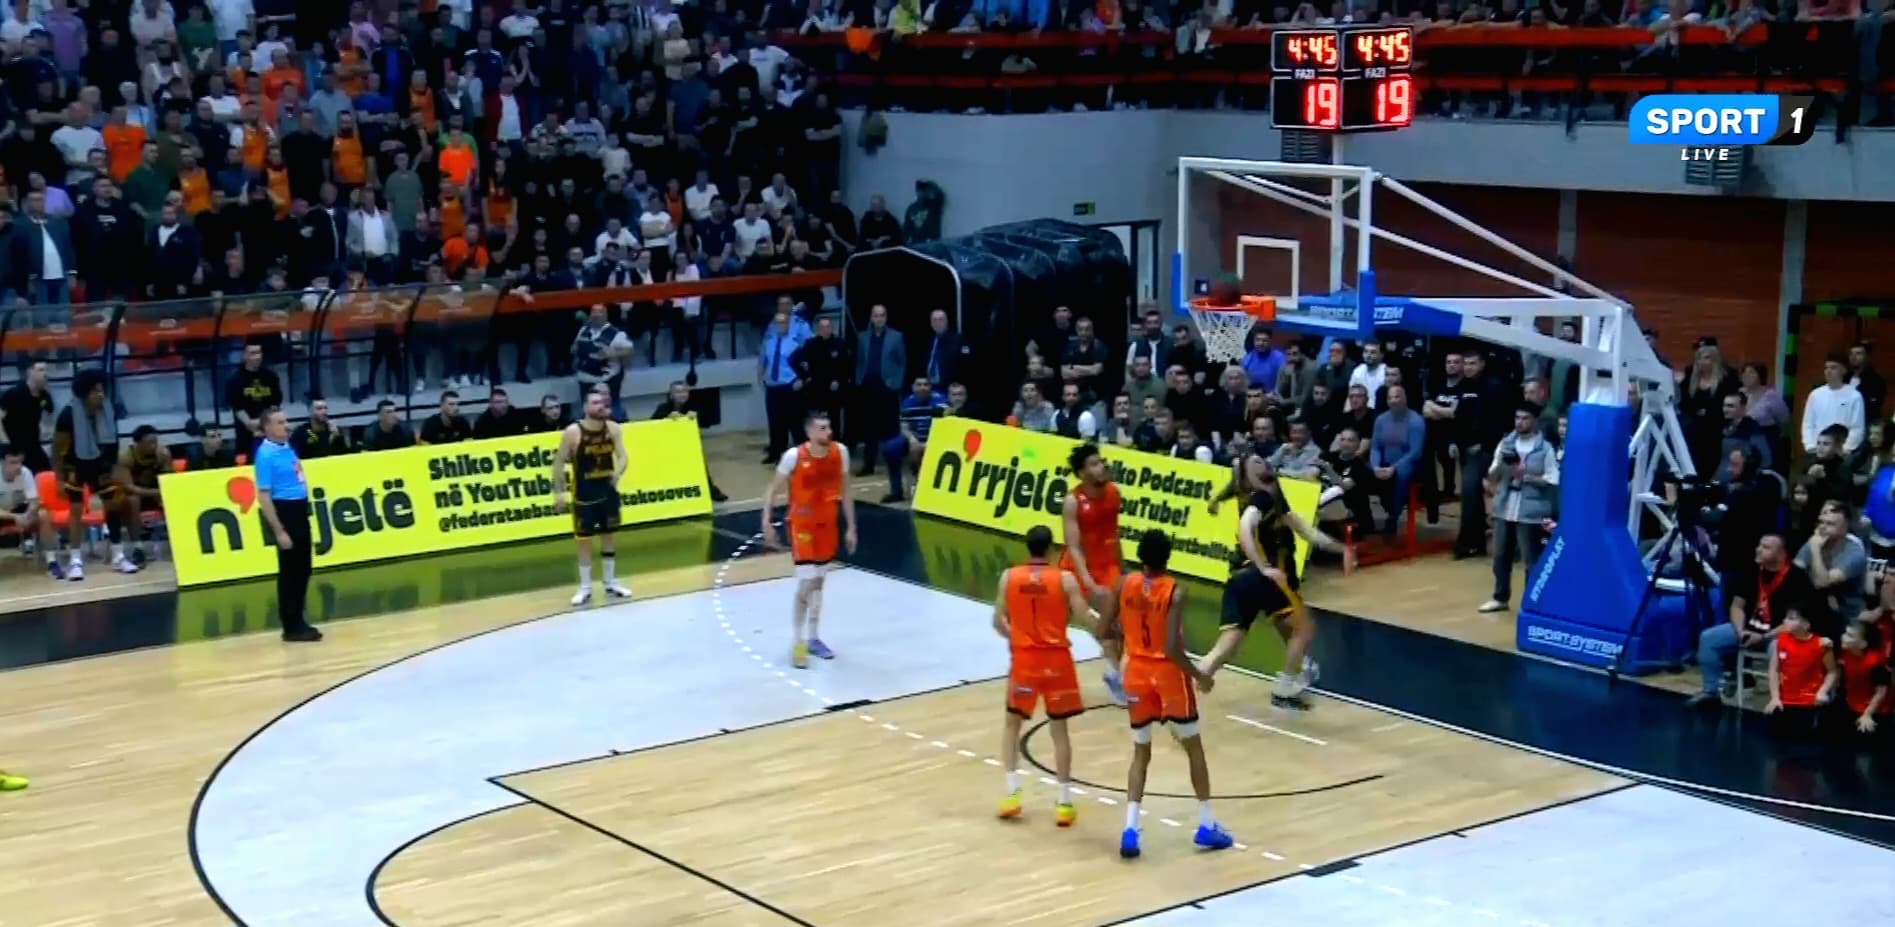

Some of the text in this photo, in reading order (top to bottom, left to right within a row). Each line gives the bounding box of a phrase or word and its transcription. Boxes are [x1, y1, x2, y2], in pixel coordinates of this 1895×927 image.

[1288, 35, 1337, 64] 4:45
[1357, 32, 1411, 62] 4:45
[1307, 83, 1337, 126] 19
[1377, 79, 1409, 122] 19
[429, 454, 493, 480] Shiko
[496, 446, 562, 471] Podc
[435, 484, 463, 508] në
[1139, 467, 1212, 500] Podcast
[1120, 497, 1190, 527] ouTube!
